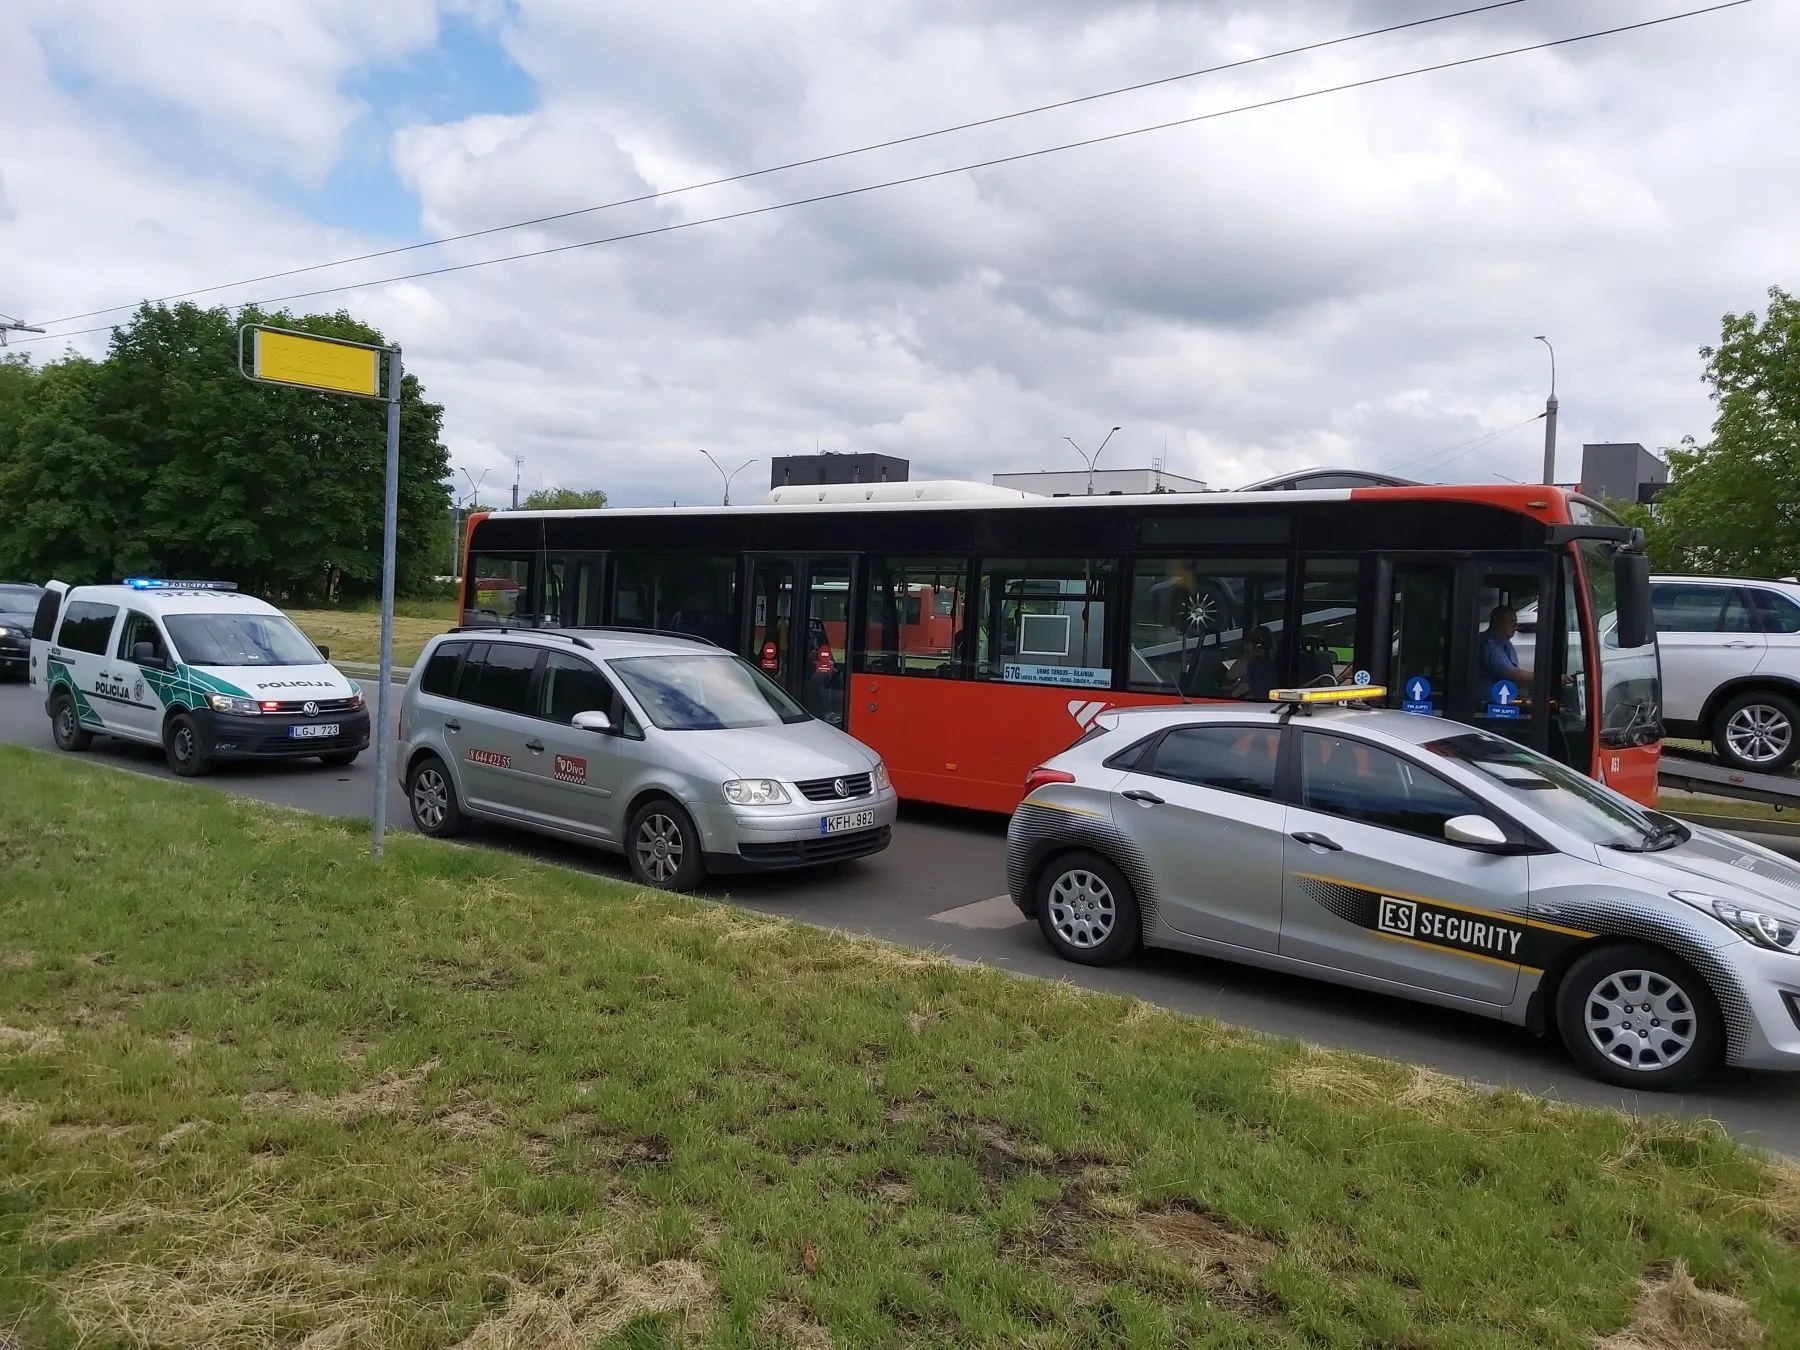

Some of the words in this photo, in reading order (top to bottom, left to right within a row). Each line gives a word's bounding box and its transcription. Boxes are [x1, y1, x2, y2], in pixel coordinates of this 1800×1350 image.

[95, 681, 130, 700] POLICIJA
[256, 680, 336, 690] POLICIJA
[295, 726, 316, 737] LGJ
[321, 725, 338, 736] 723
[470, 749, 475, 760] 8
[475, 750, 489, 763] 644
[489, 753, 501, 766] 422
[501, 756, 511, 768] 55
[828, 815, 851, 831] KFH
[856, 811, 873, 826] 982
[1384, 903, 1410, 930] ES
[1420, 911, 1522, 955] SECURITY
